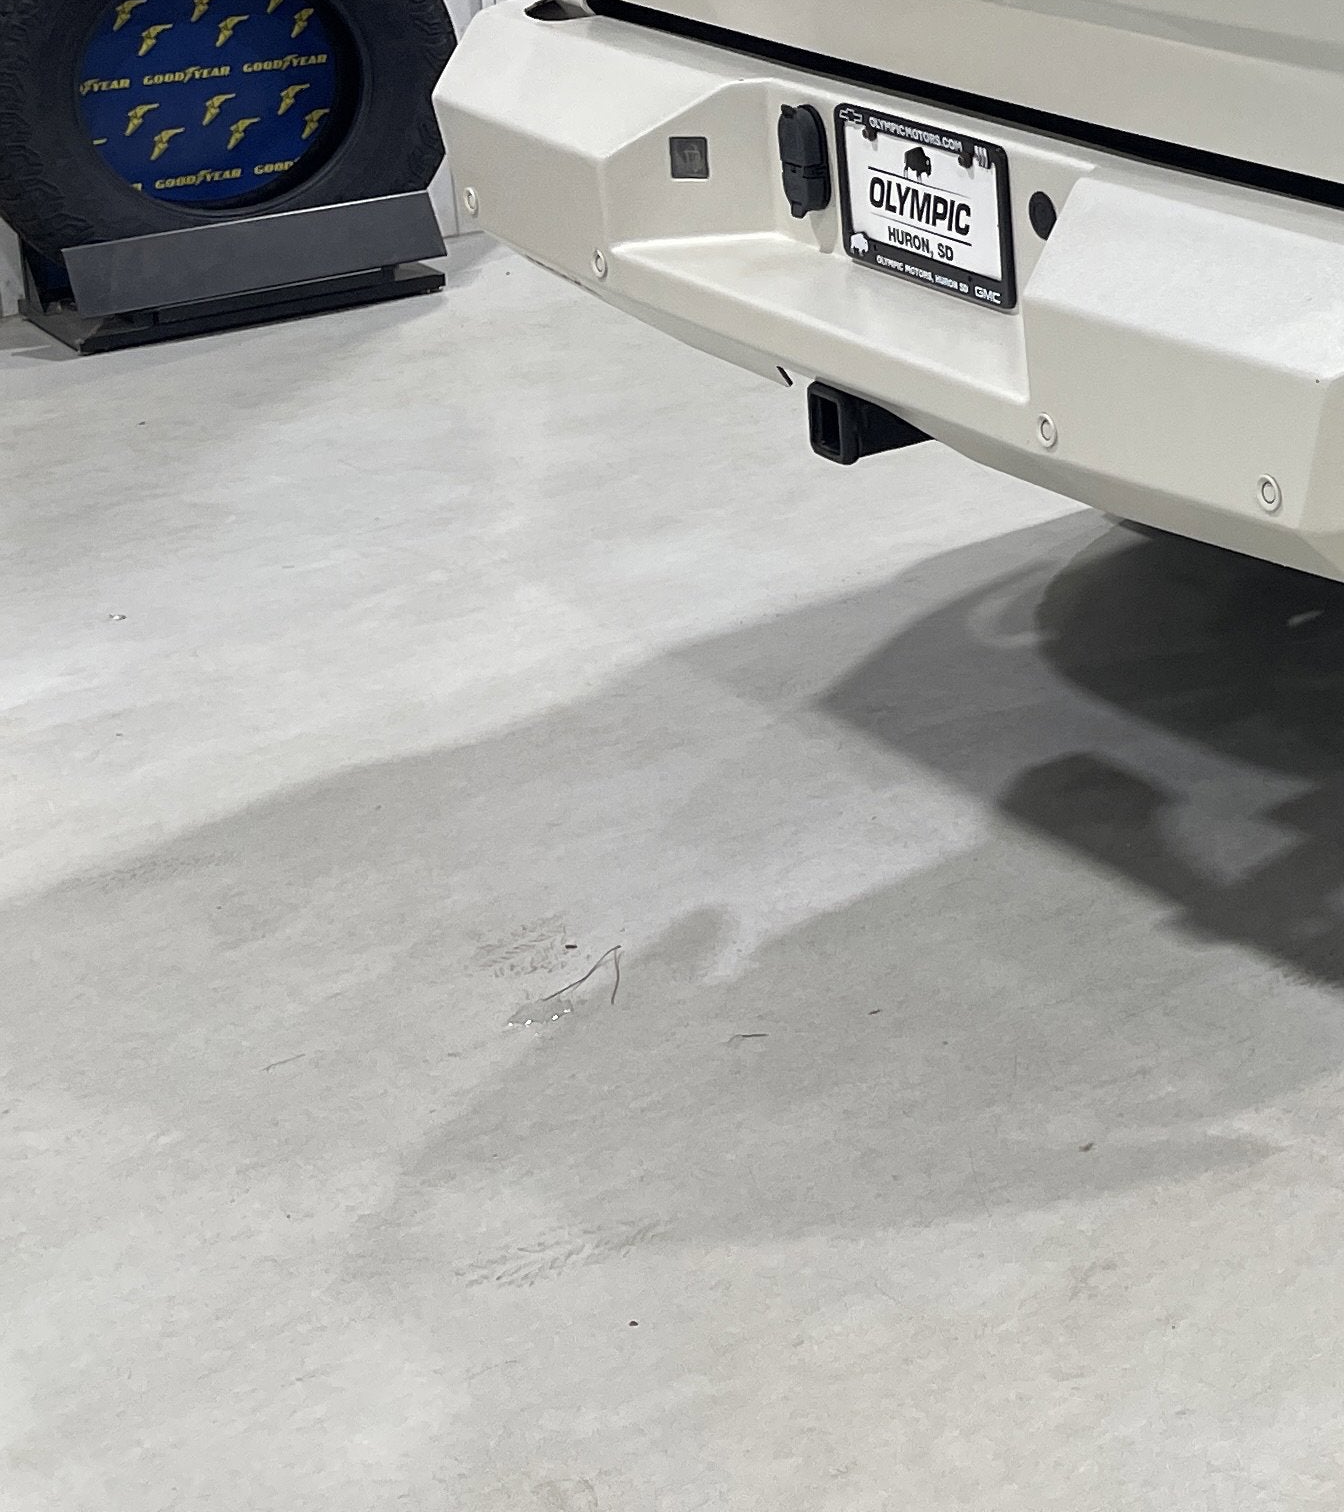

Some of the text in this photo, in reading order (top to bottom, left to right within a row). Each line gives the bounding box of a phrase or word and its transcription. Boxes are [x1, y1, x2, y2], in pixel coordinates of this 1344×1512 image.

[143, 65, 231, 86] GOODYEAR
[242, 54, 328, 76] GOODYEAR
[155, 168, 242, 189] GOODYEAR
[869, 176, 971, 236] OLYMPIC
[888, 225, 954, 261] HURON, SD
[876, 254, 904, 272] OLYMPIC
[974, 285, 1001, 304] GMC
